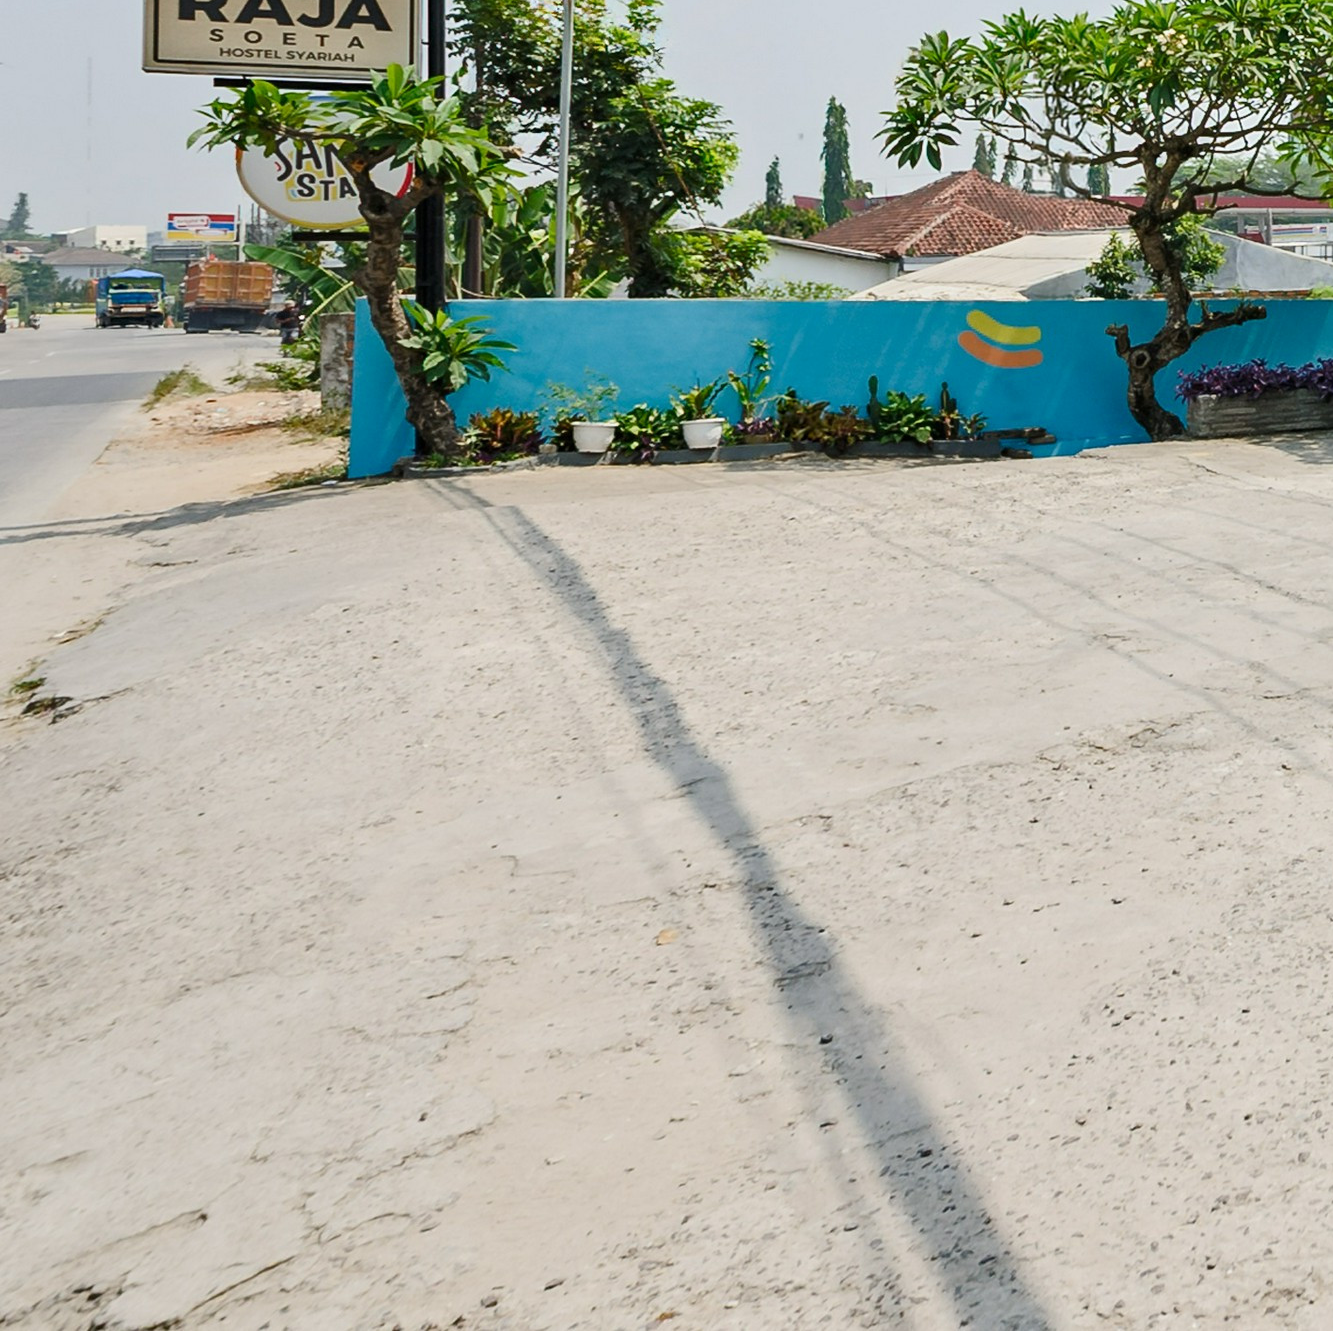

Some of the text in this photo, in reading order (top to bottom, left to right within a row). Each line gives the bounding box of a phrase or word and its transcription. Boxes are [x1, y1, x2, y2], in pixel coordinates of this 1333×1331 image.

[209, 28, 364, 50] SOETA
[219, 47, 355, 63] HOSTEL SYARIAH
[296, 173, 358, 201] STA
